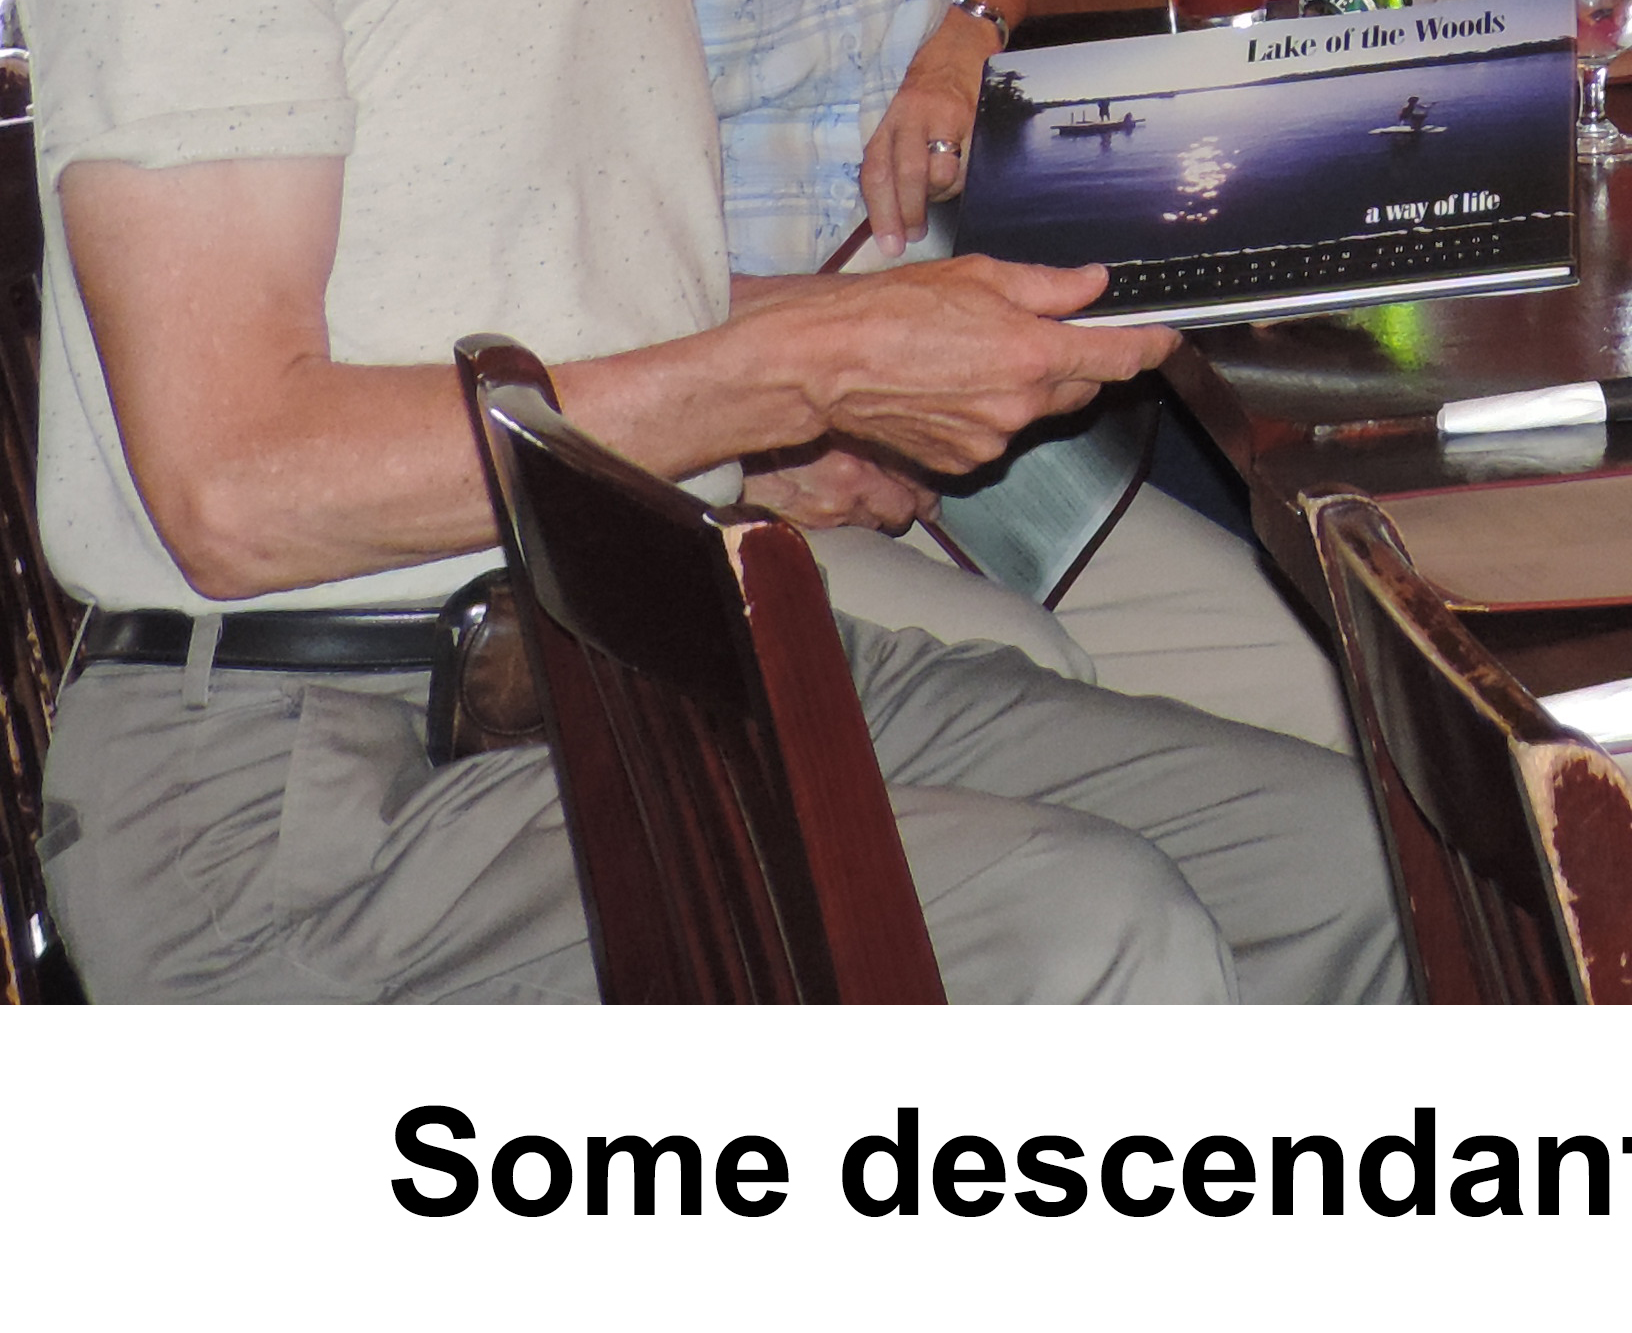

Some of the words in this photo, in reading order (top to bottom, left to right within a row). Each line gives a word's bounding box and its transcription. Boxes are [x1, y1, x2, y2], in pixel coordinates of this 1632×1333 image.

[1247, 35, 1318, 63] Lake
[1325, 27, 1356, 54] of
[1361, 24, 1406, 49] the
[1415, 10, 1506, 42] Woods
[1364, 206, 1382, 224] a
[1386, 201, 1430, 224] way
[1433, 193, 1459, 216] of
[1462, 190, 1501, 214] life
[1304, 251, 1351, 264] TOM
